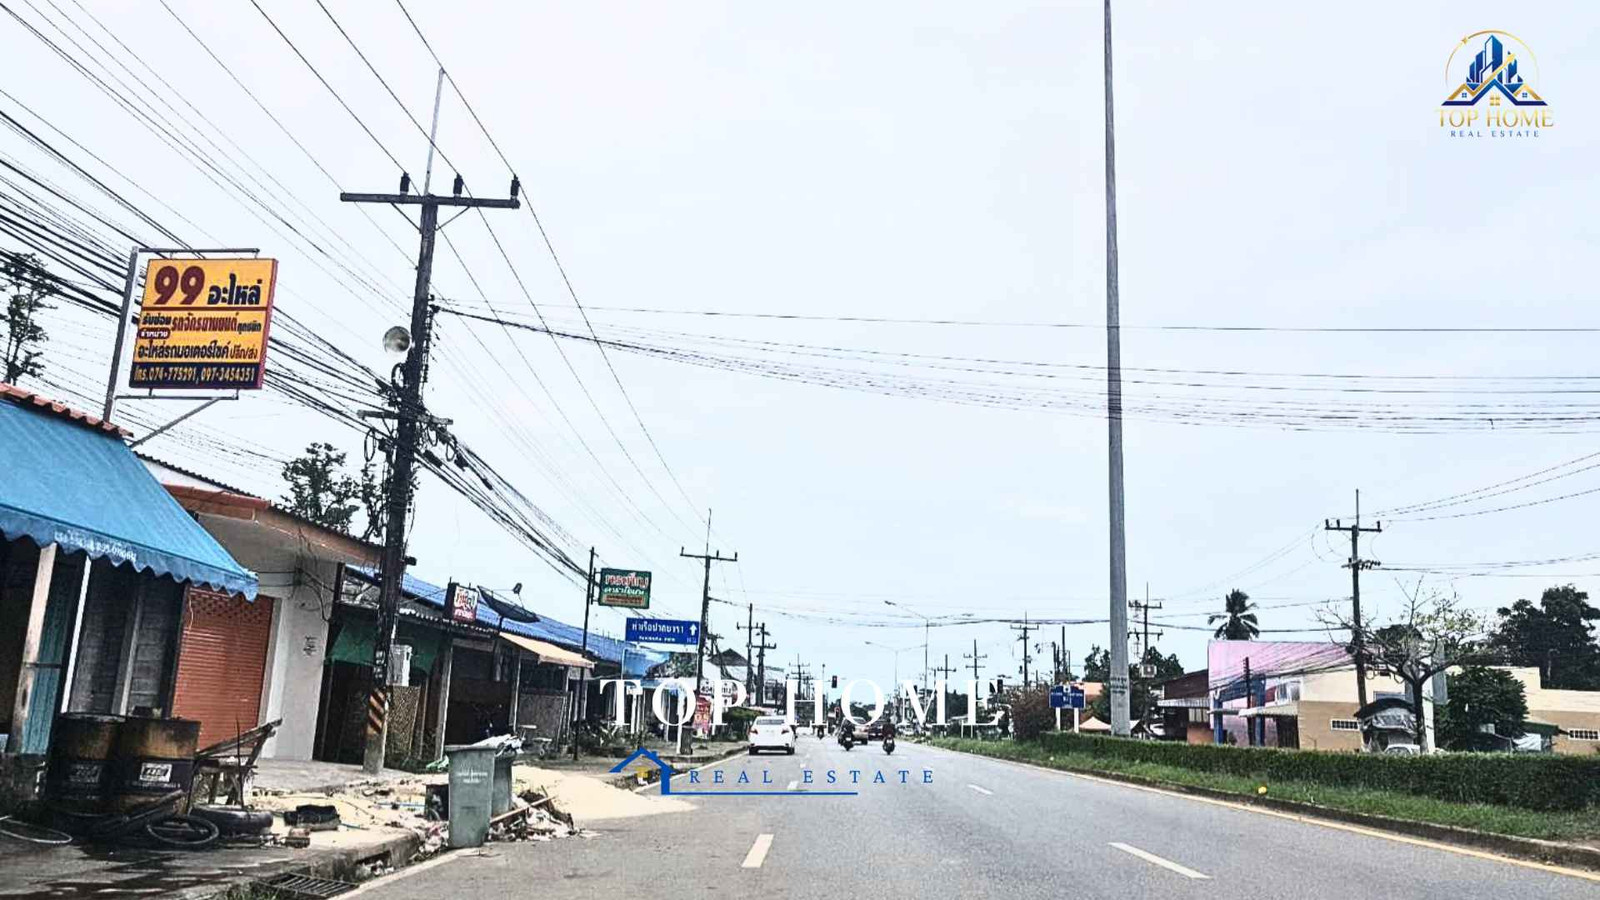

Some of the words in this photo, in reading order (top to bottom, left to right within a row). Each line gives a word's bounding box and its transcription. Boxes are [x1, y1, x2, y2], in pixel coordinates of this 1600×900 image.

[153, 265, 205, 305] 99
[207, 272, 263, 305] อะไหล่
[171, 312, 239, 332] รถจักรยานยนต์
[140, 328, 168, 338] จำหน่าย
